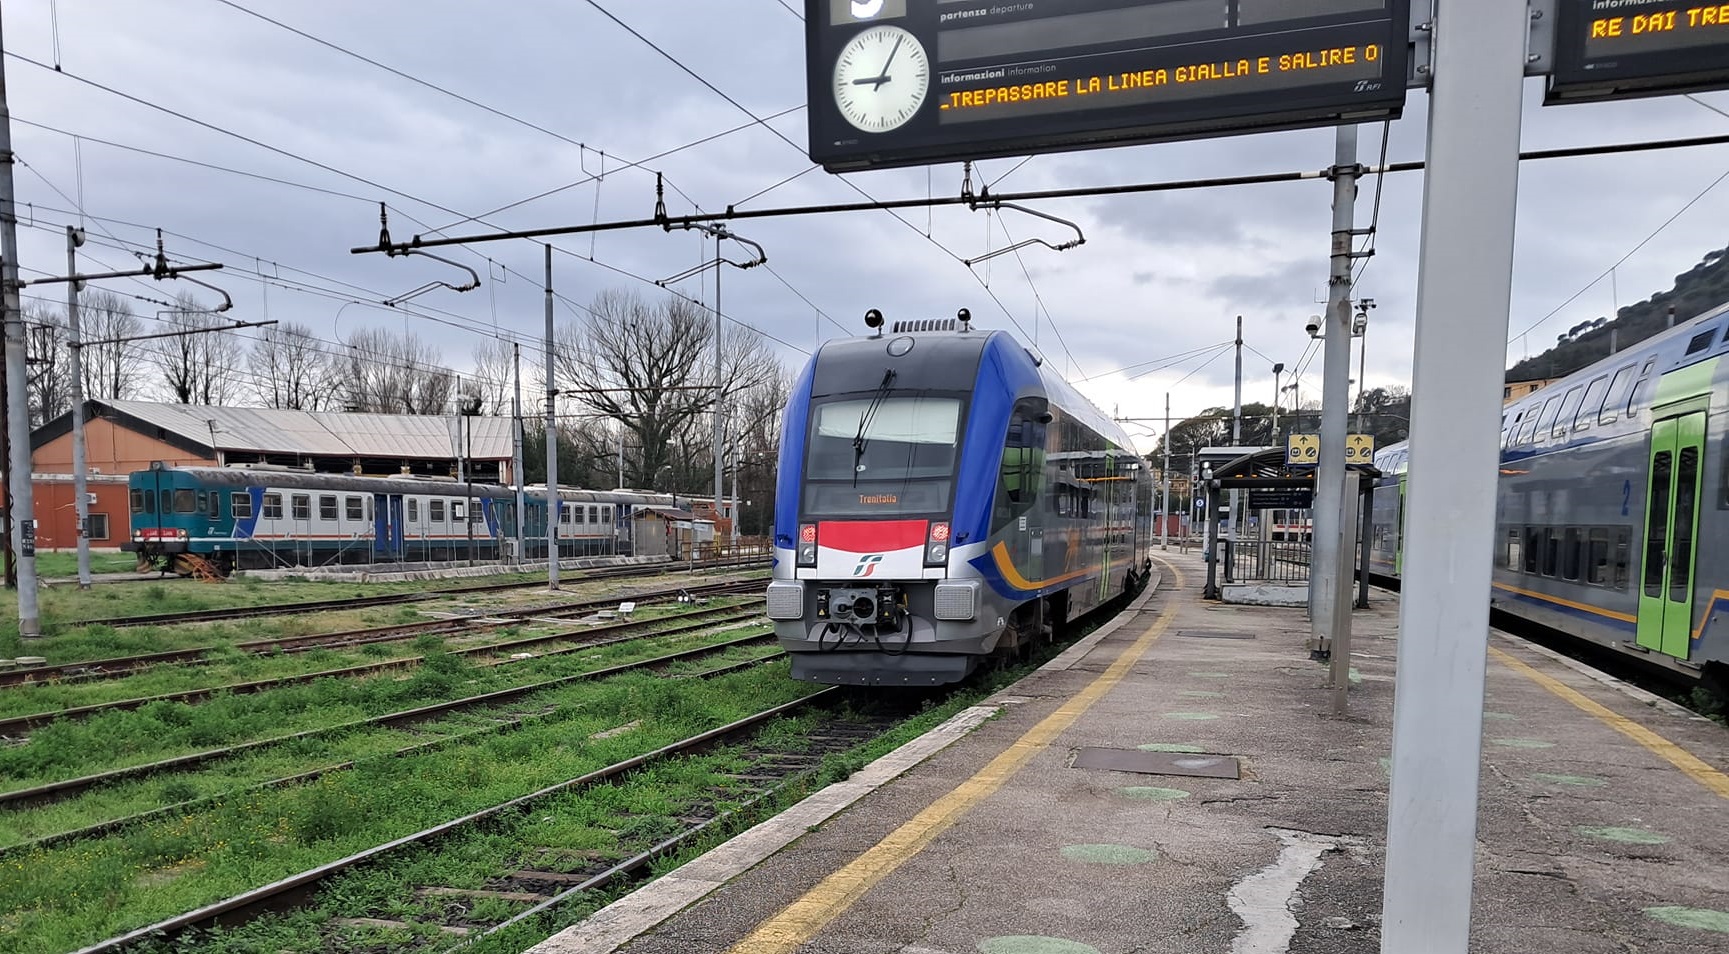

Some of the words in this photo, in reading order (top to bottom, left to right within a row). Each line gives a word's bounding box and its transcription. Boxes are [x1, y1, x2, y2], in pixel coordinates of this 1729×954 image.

[940, 8, 987, 22] partenza
[990, 2, 1034, 15] departure
[1593, 0, 1664, 10] informa
[1592, 17, 1624, 38] RE
[1632, 11, 1677, 34] DAI
[1687, 5, 1729, 27] TRE
[941, 68, 1005, 84] informazioni
[1007, 64, 1056, 76] information
[1076, 77, 1101, 94] LA
[1108, 69, 1167, 91] LINEA
[1175, 60, 1249, 83] GIALLA
[1258, 57, 1270, 73] E
[1279, 47, 1356, 71] SALIRE
[859, 494, 897, 504] Trenitalia
[1621, 480, 1630, 516] 2
